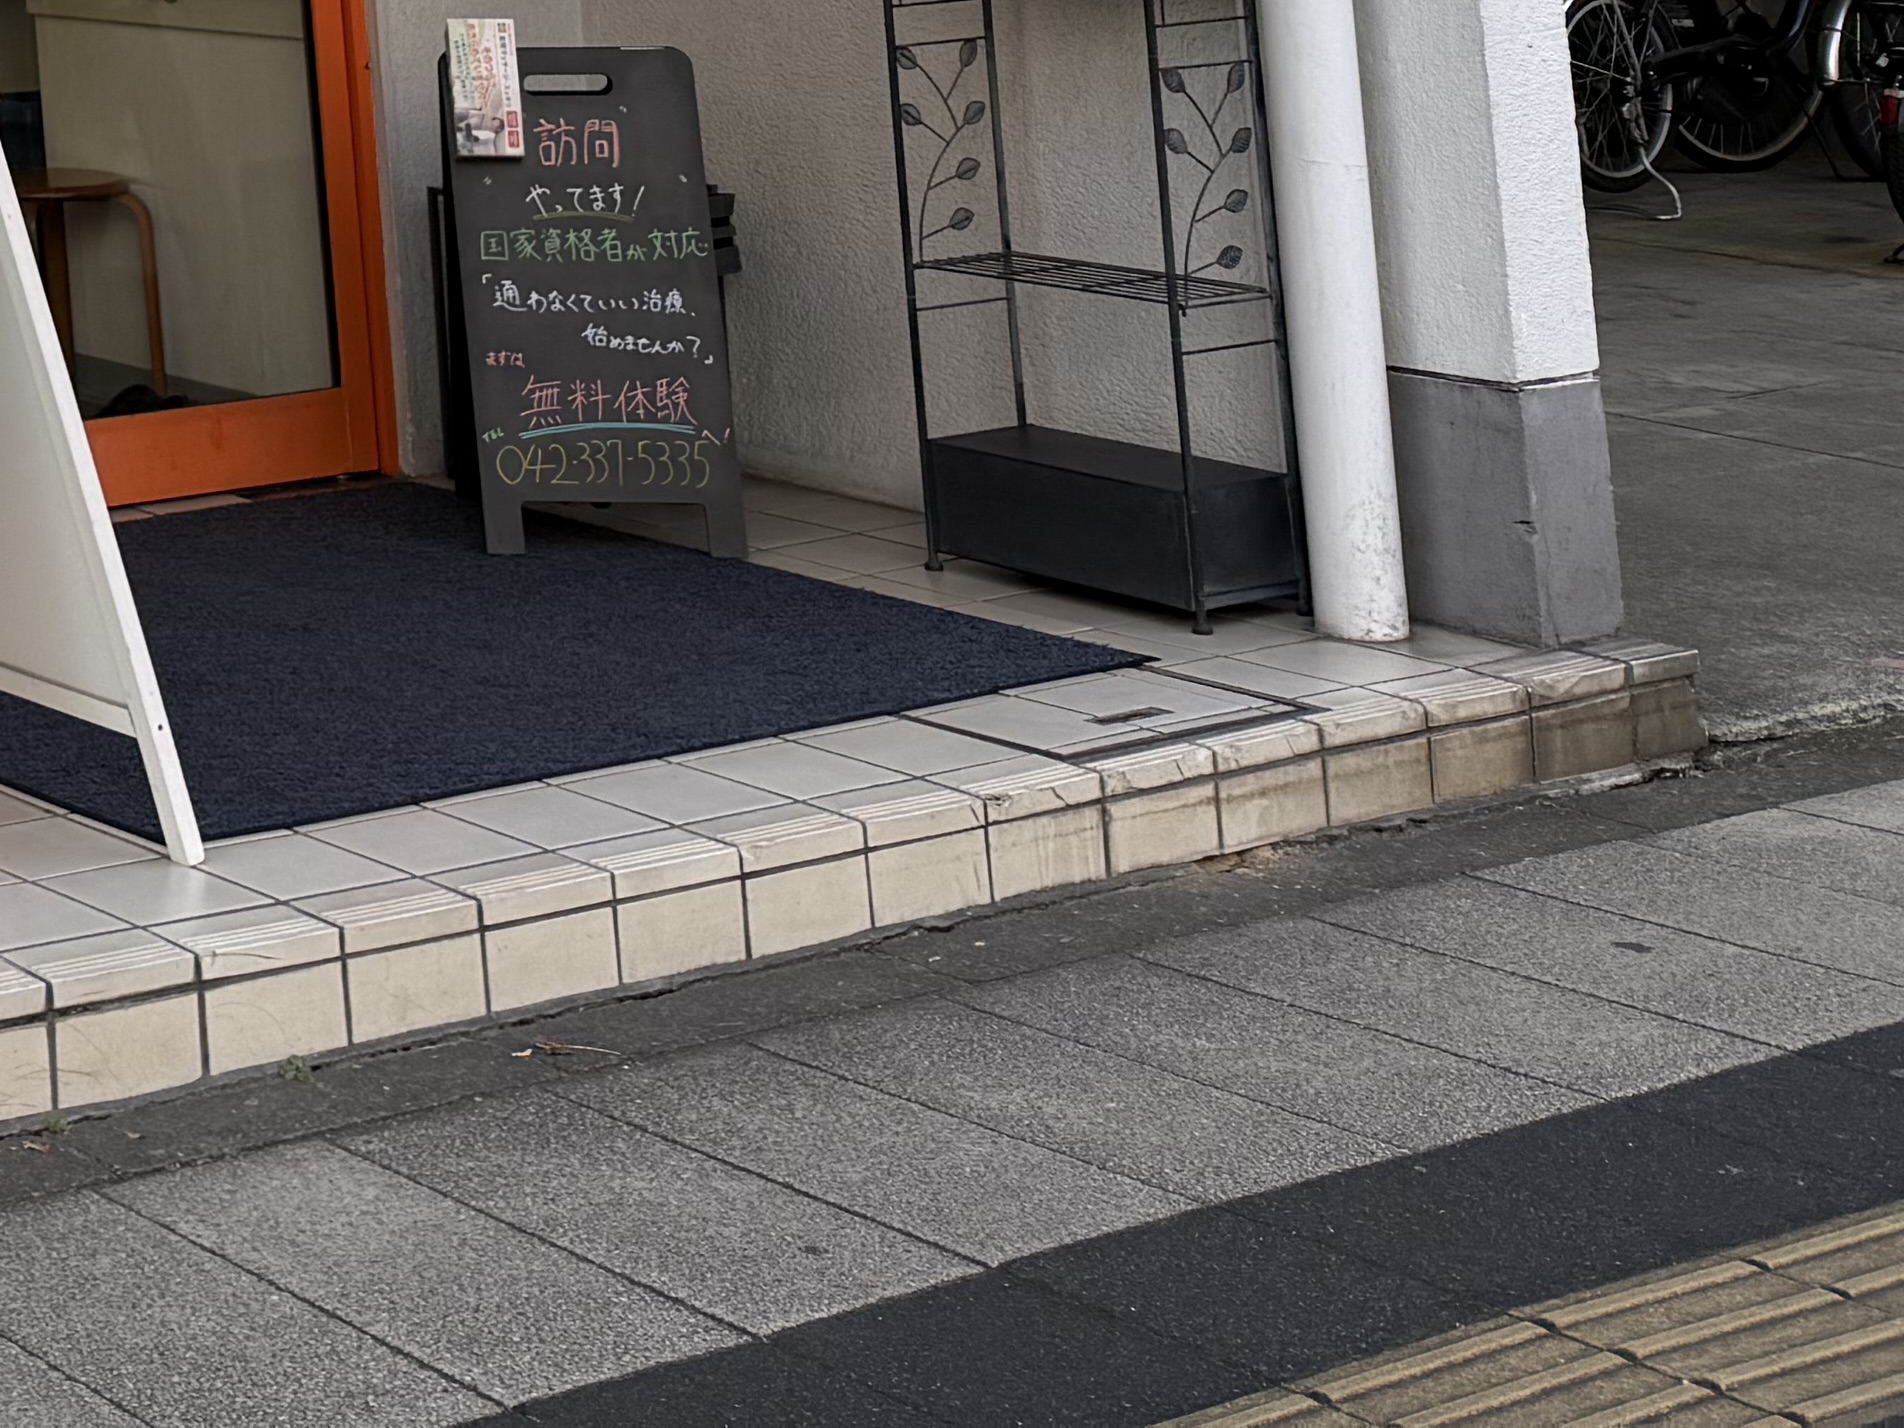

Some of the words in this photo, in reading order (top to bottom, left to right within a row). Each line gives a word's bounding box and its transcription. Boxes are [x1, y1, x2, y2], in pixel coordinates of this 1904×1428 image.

[533, 117, 621, 168] 訪問
[524, 182, 645, 218] やってます!
[480, 225, 709, 263] 国家資格者が対応
[485, 351, 526, 368] まずは
[481, 427, 505, 443] TEL
[496, 439, 711, 489] 042-337-5335
